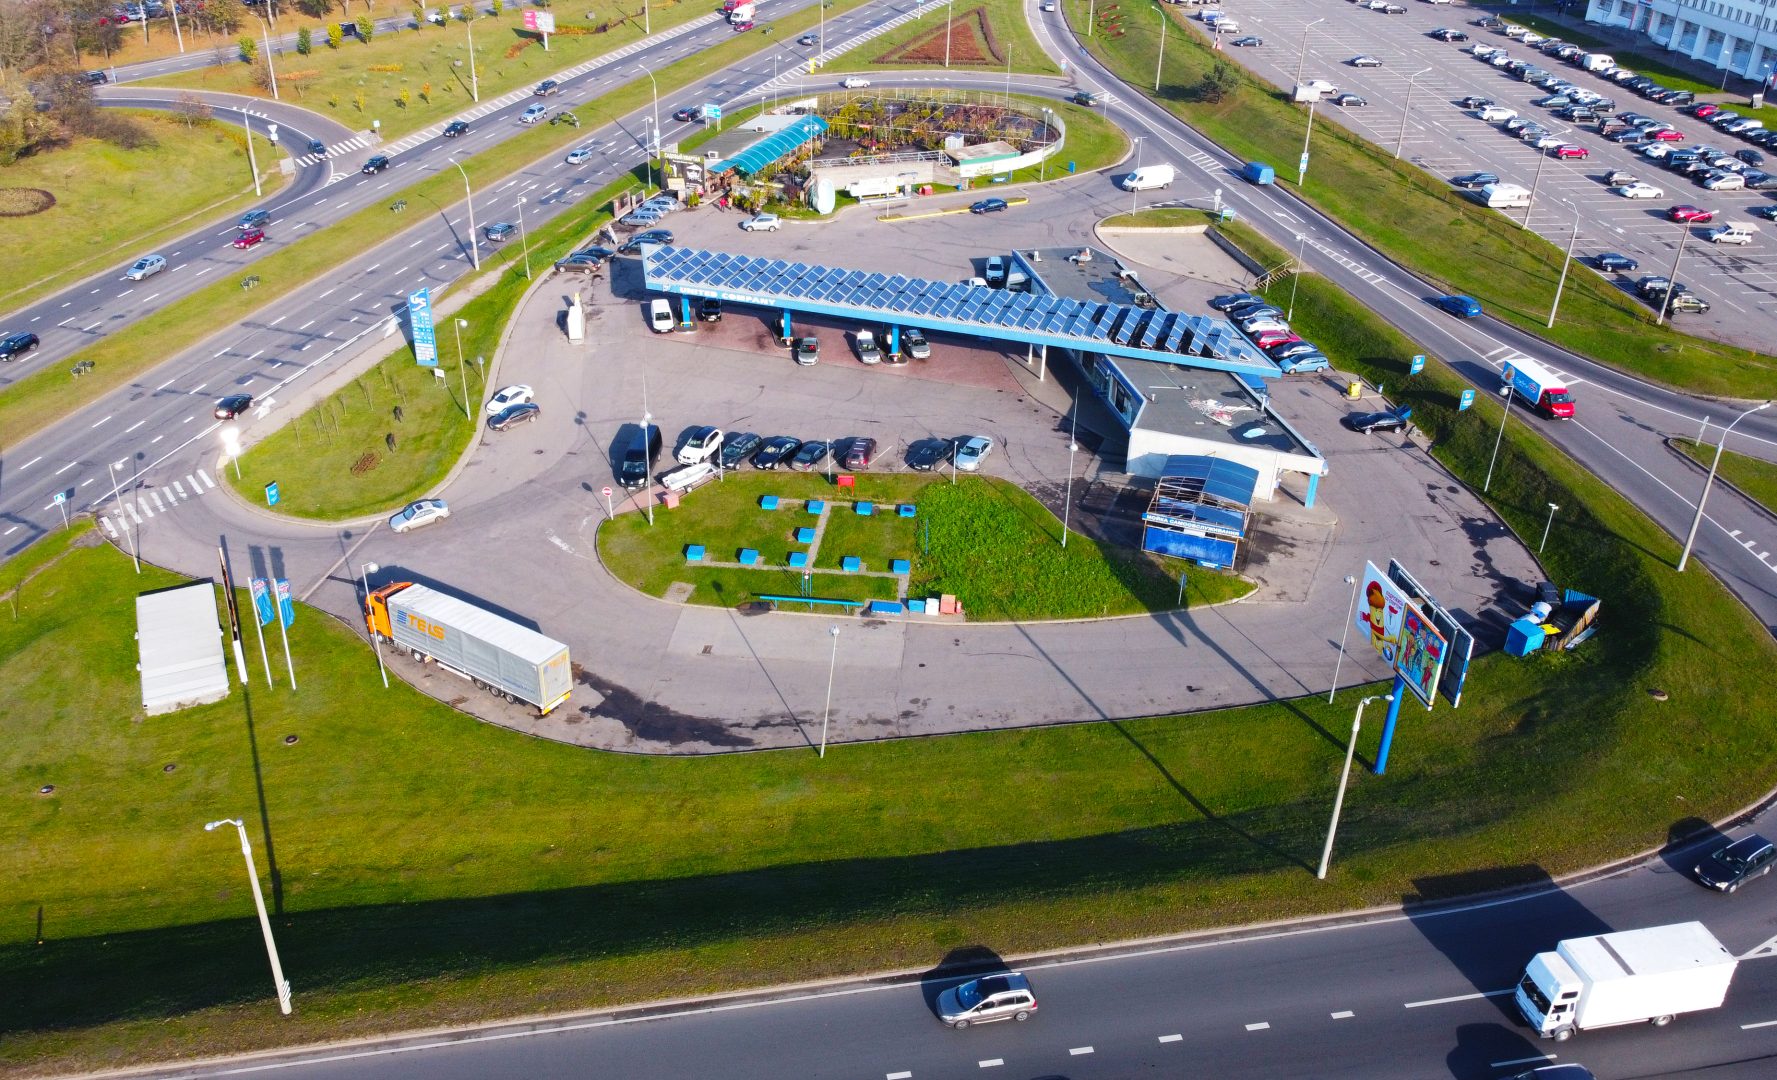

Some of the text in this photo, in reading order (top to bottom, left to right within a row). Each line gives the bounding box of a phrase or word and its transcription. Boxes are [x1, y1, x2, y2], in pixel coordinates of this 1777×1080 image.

[680, 287, 776, 305] UNITED COMPANY
[408, 613, 445, 640] TELS
